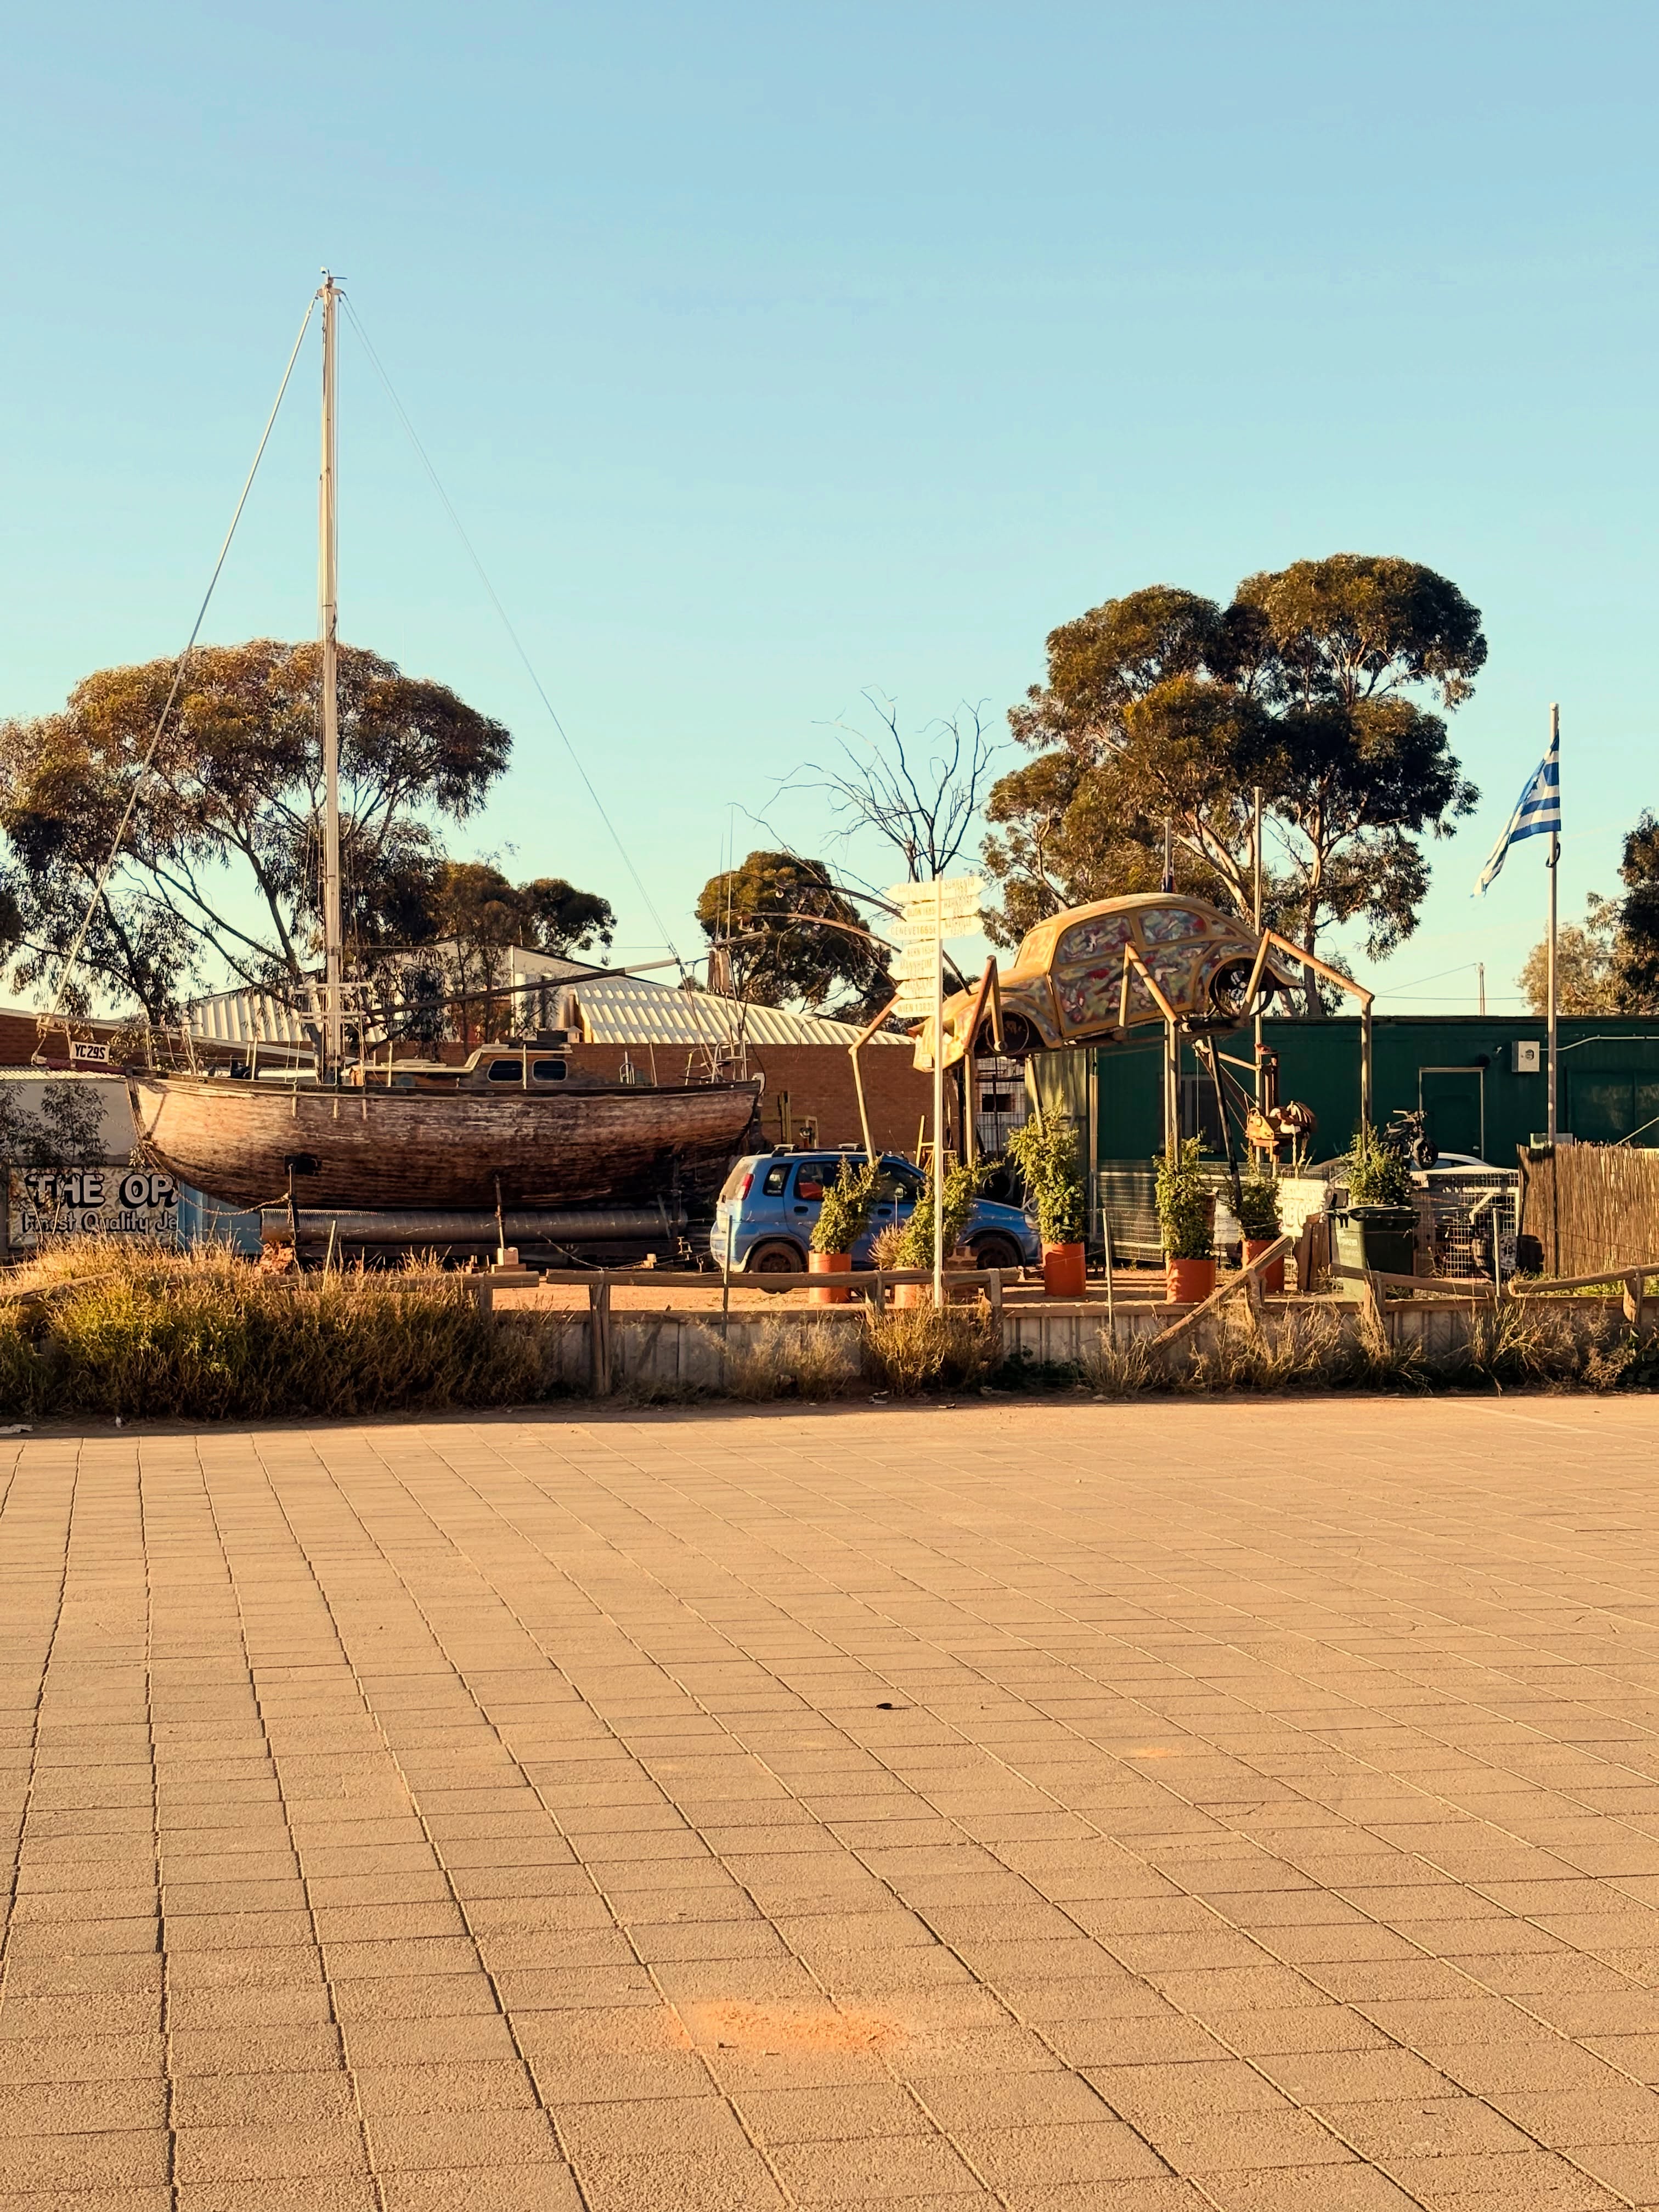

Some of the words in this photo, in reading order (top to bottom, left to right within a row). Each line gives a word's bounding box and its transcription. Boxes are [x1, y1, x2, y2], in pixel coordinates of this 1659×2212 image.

[907, 947, 920, 957] BERN
[900, 958, 932, 970] MANNHEIM
[898, 1004, 913, 1013] WIEN
[25, 1173, 106, 1209] THE
[81, 1210, 150, 1234] Quality
